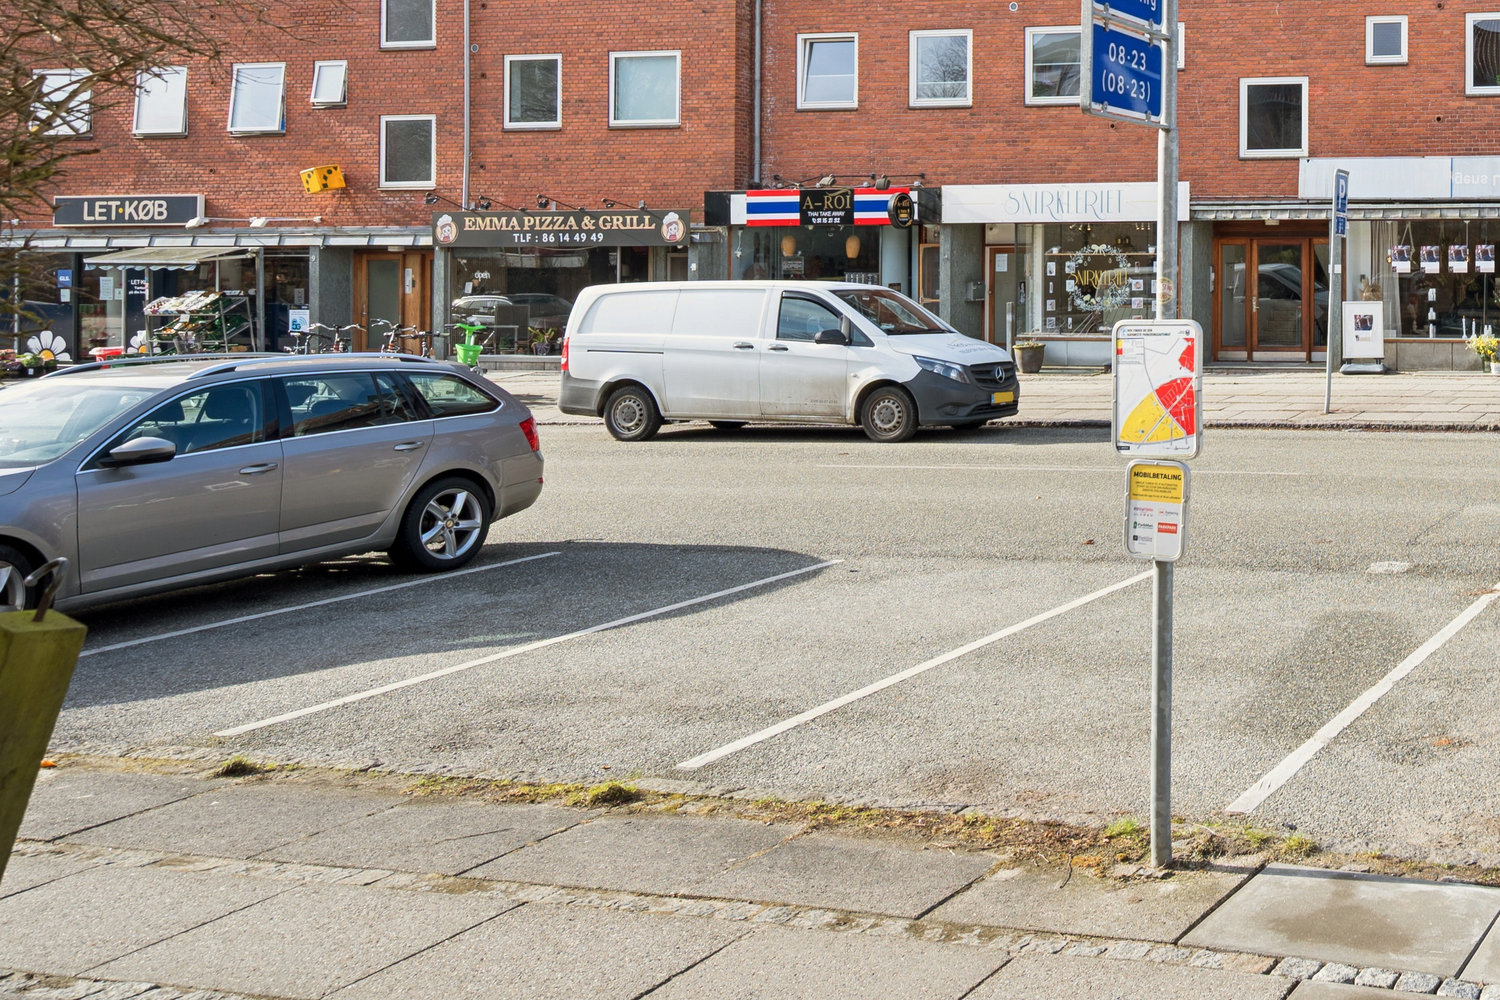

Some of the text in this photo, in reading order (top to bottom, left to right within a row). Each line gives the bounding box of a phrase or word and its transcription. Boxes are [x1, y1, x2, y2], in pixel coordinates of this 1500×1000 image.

[1339, 179, 1346, 209] P
[802, 194, 851, 210] A-ROI
[464, 215, 656, 231] EMMA PIZZA & GRILL
[513, 233, 532, 243] TLF
[542, 233, 555, 243] 86
[558, 233, 570, 243] 14
[574, 233, 587, 243] 49
[590, 233, 604, 243] 49
[474, 271, 491, 282] open
[1133, 471, 1182, 481] MOBILBETALING
